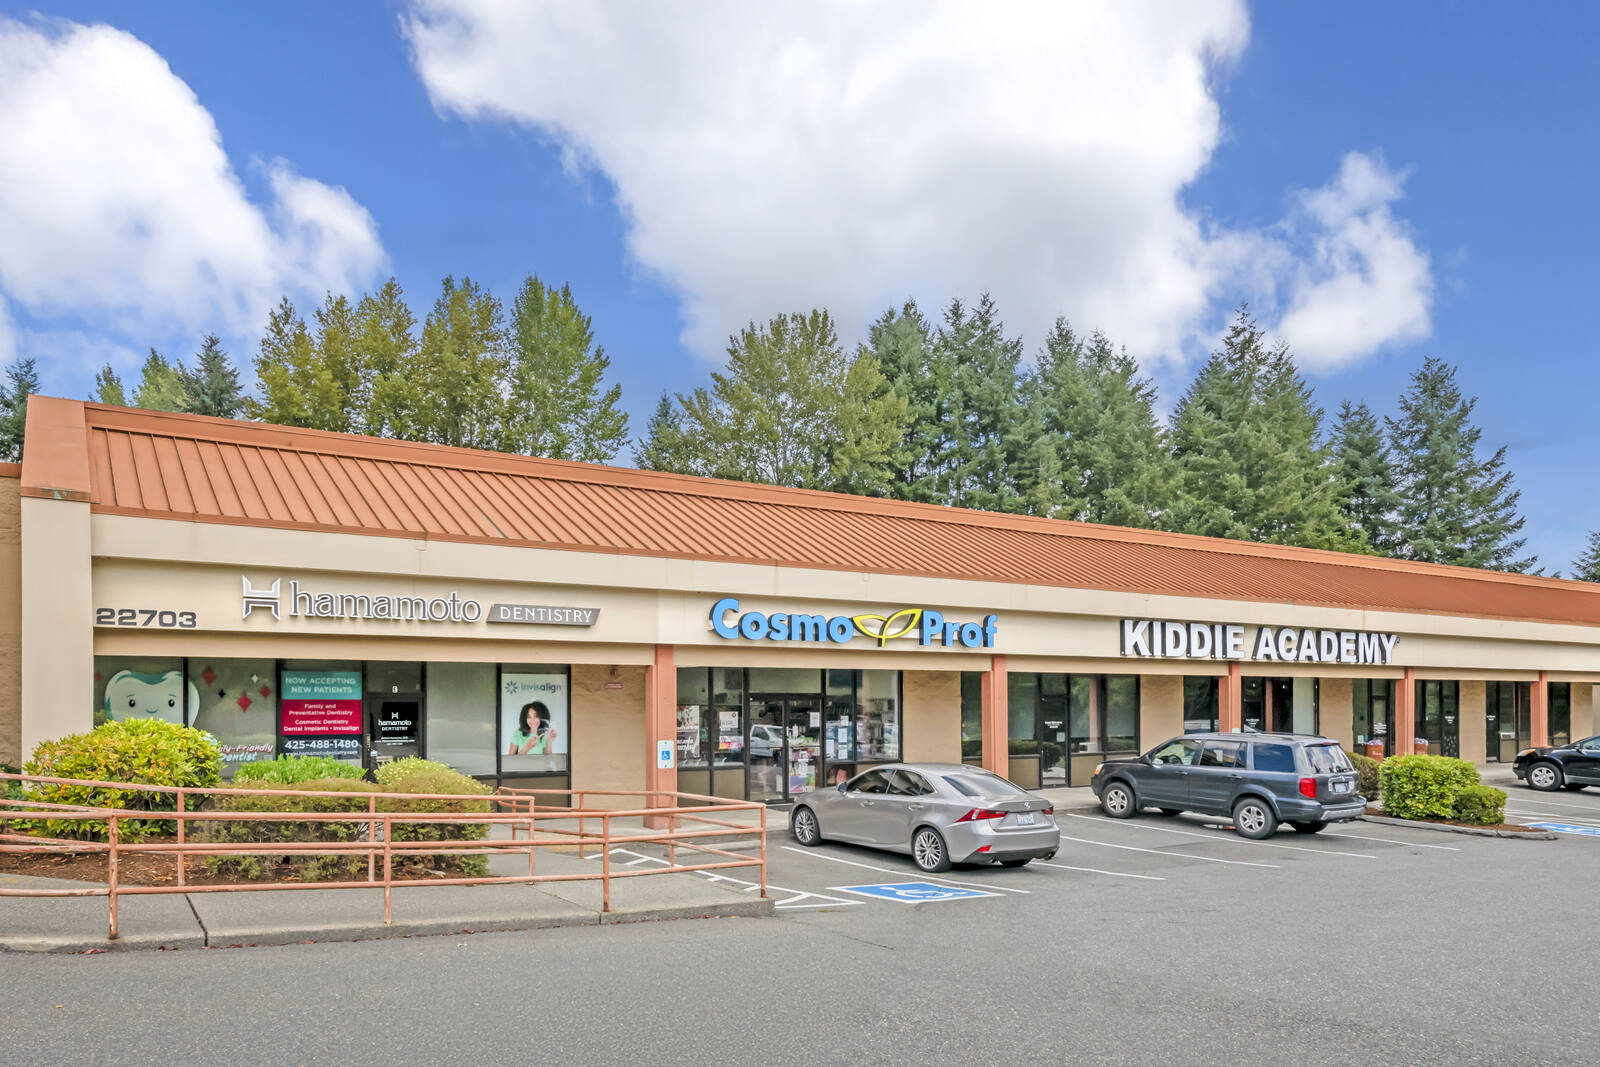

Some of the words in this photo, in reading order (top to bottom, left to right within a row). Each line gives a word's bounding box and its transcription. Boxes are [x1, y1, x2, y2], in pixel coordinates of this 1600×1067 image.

[289, 580, 483, 622] hamamoto
[499, 606, 593, 623] DENTISTRY
[96, 607, 197, 628] 22703
[709, 597, 855, 644] Cosmo
[919, 609, 998, 648] Prof
[1120, 618, 1246, 659] KIDDIE
[1252, 626, 1398, 664] ACADEMY
[285, 677, 307, 685] NOW
[310, 677, 356, 685] ACCEPTING
[520, 681, 562, 693] invisalign
[291, 686, 312, 694] NEW
[313, 686, 353, 694] PATIENTS
[284, 739, 359, 749] 425-488-1480
